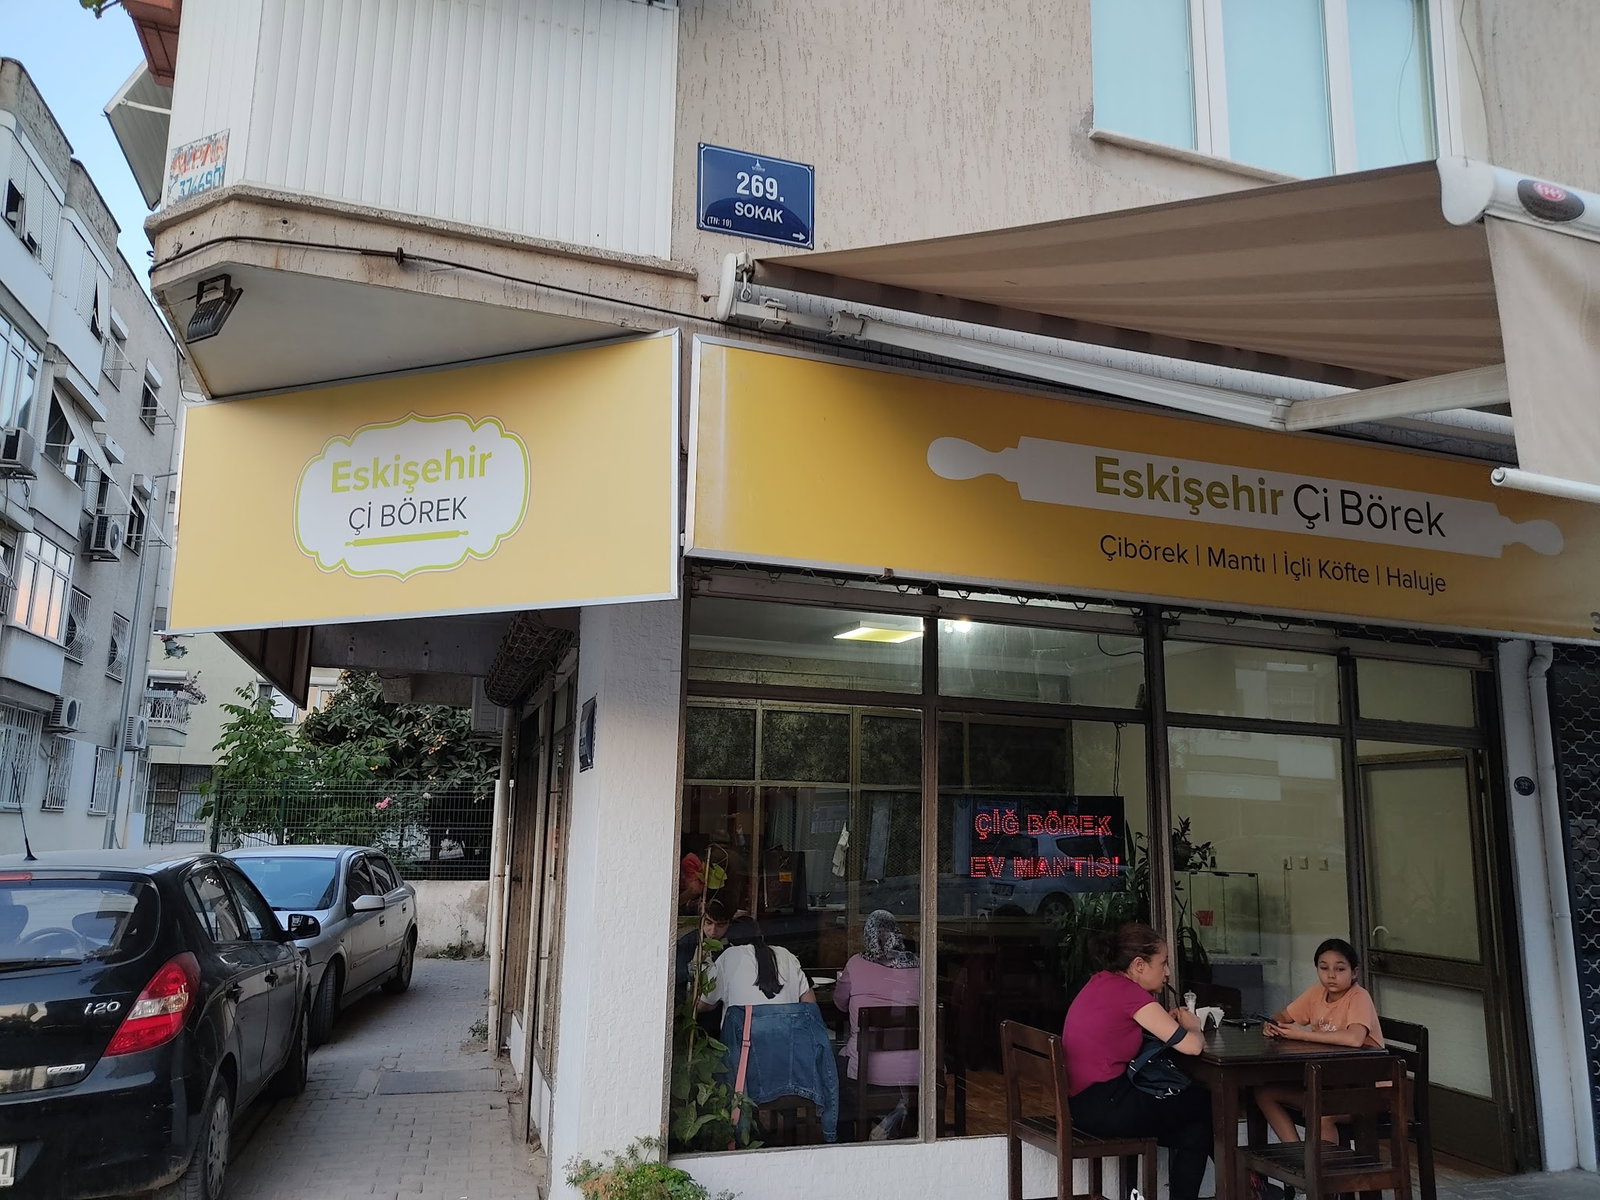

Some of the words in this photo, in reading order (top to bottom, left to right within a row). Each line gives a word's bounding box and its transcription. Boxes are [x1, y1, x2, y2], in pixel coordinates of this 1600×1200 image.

[736, 171, 785, 203] 269.
[734, 201, 784, 224] SOKAK
[330, 445, 493, 494] Eskişehir
[380, 496, 468, 528] BÖREK
[1095, 455, 1284, 516] Eskişehir
[1293, 483, 1330, 530] Çi
[1340, 488, 1447, 538] Börek
[1100, 534, 1189, 564] Çibörek
[1207, 546, 1266, 573] Mantı
[1283, 551, 1312, 581] İçli
[1318, 558, 1370, 584] Köfte
[1386, 566, 1447, 596] Haluje
[974, 809, 1020, 840] ÇİĞ
[1027, 811, 1113, 836] BÖREK
[970, 856, 1006, 878] EV
[84, 1001, 121, 1016] i20
